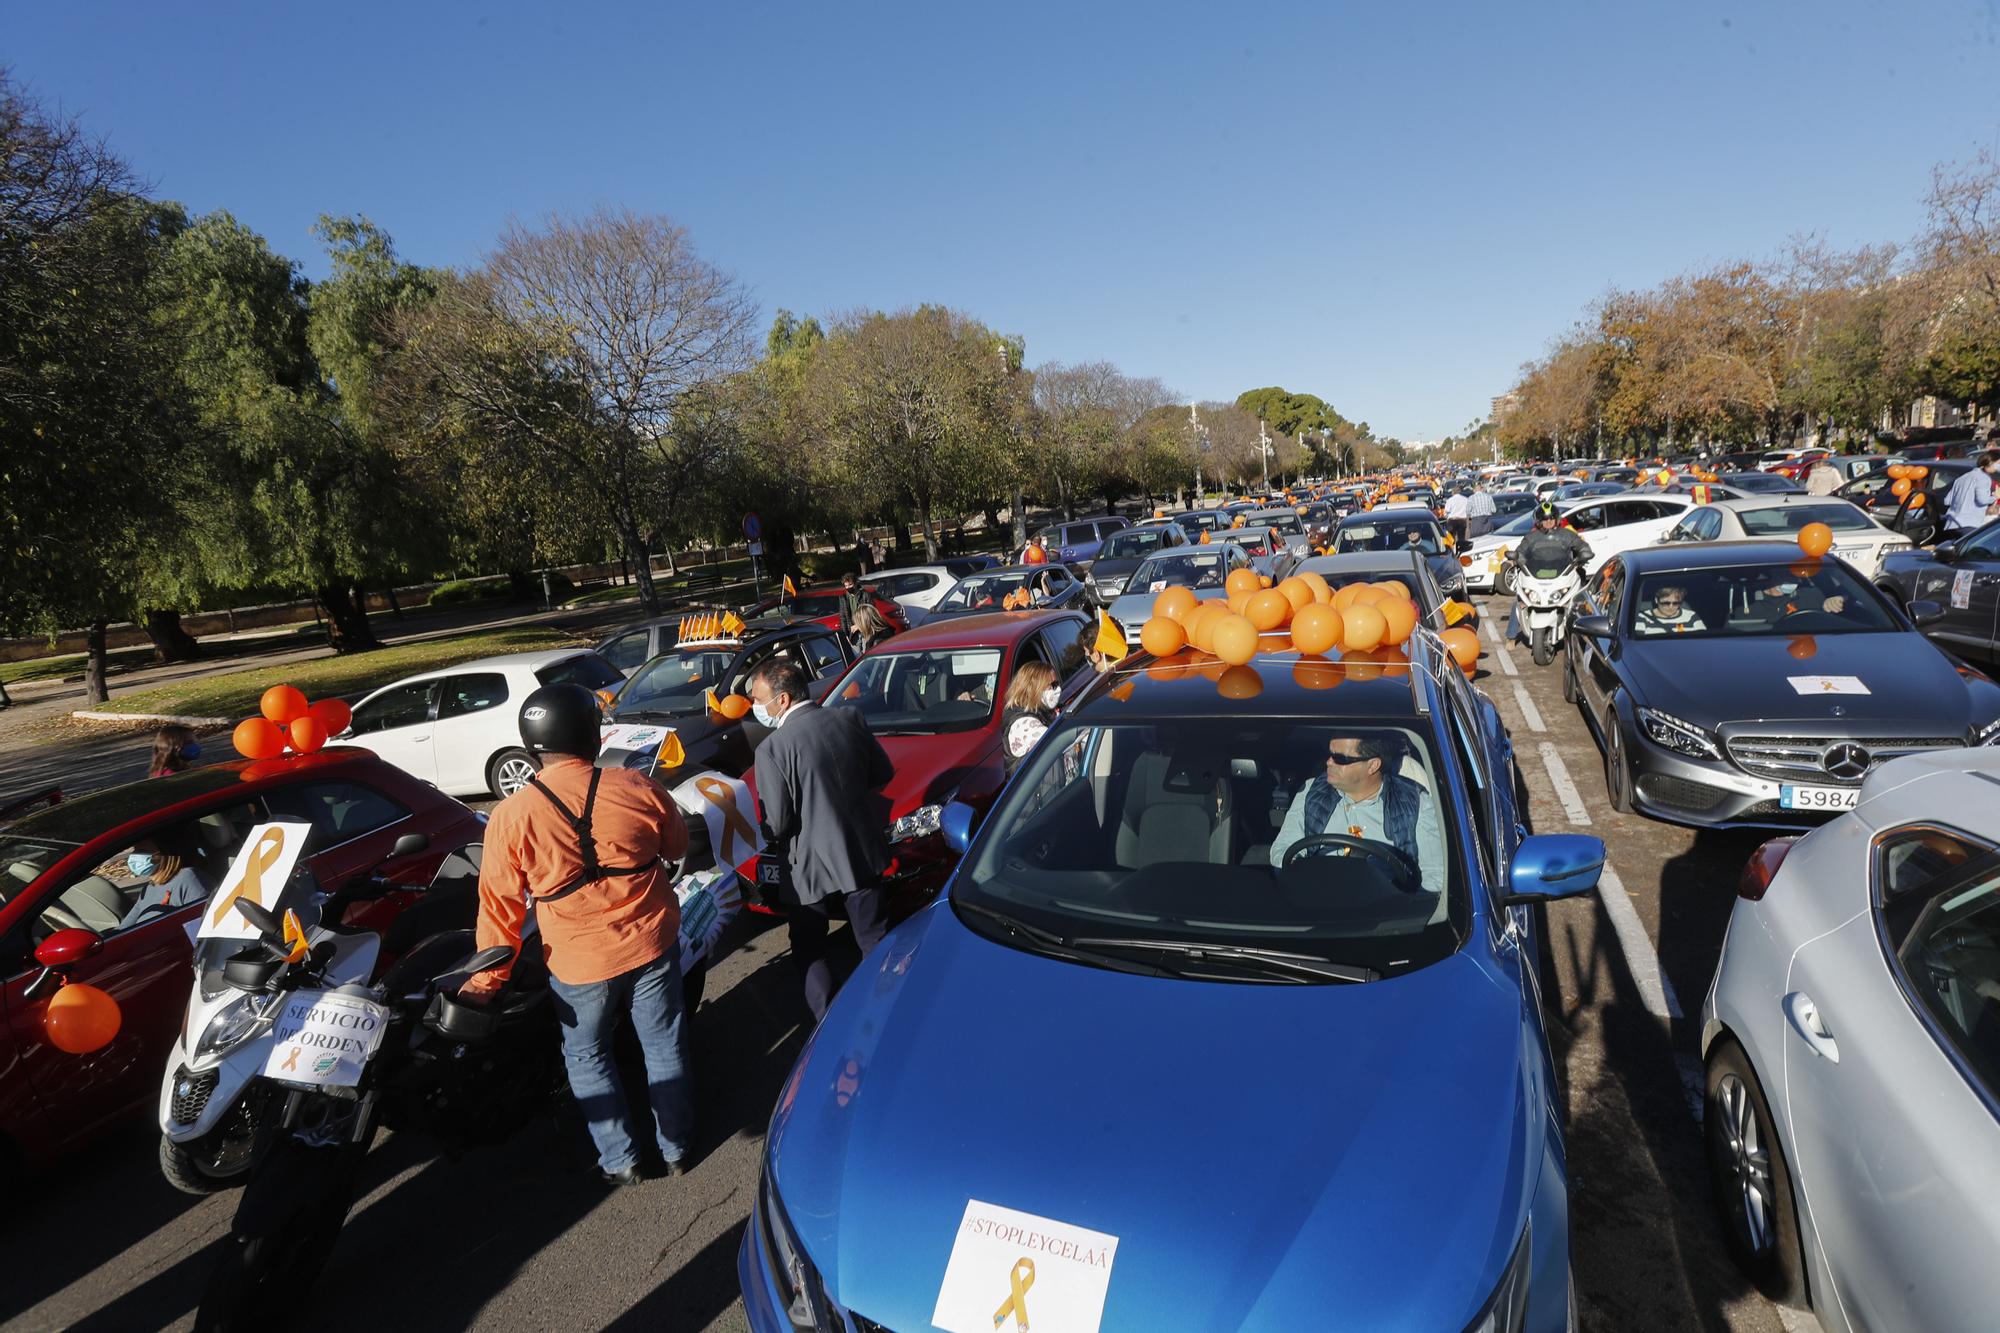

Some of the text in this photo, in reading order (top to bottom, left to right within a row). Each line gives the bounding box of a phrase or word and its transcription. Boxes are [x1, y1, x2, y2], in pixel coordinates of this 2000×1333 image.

[1799, 790, 1857, 808] 5984
[287, 1004, 375, 1032] SERVICIO
[279, 1026, 369, 1054] DE ORDEN
[965, 1215, 1108, 1268] #STOPLEYCELAÁ
